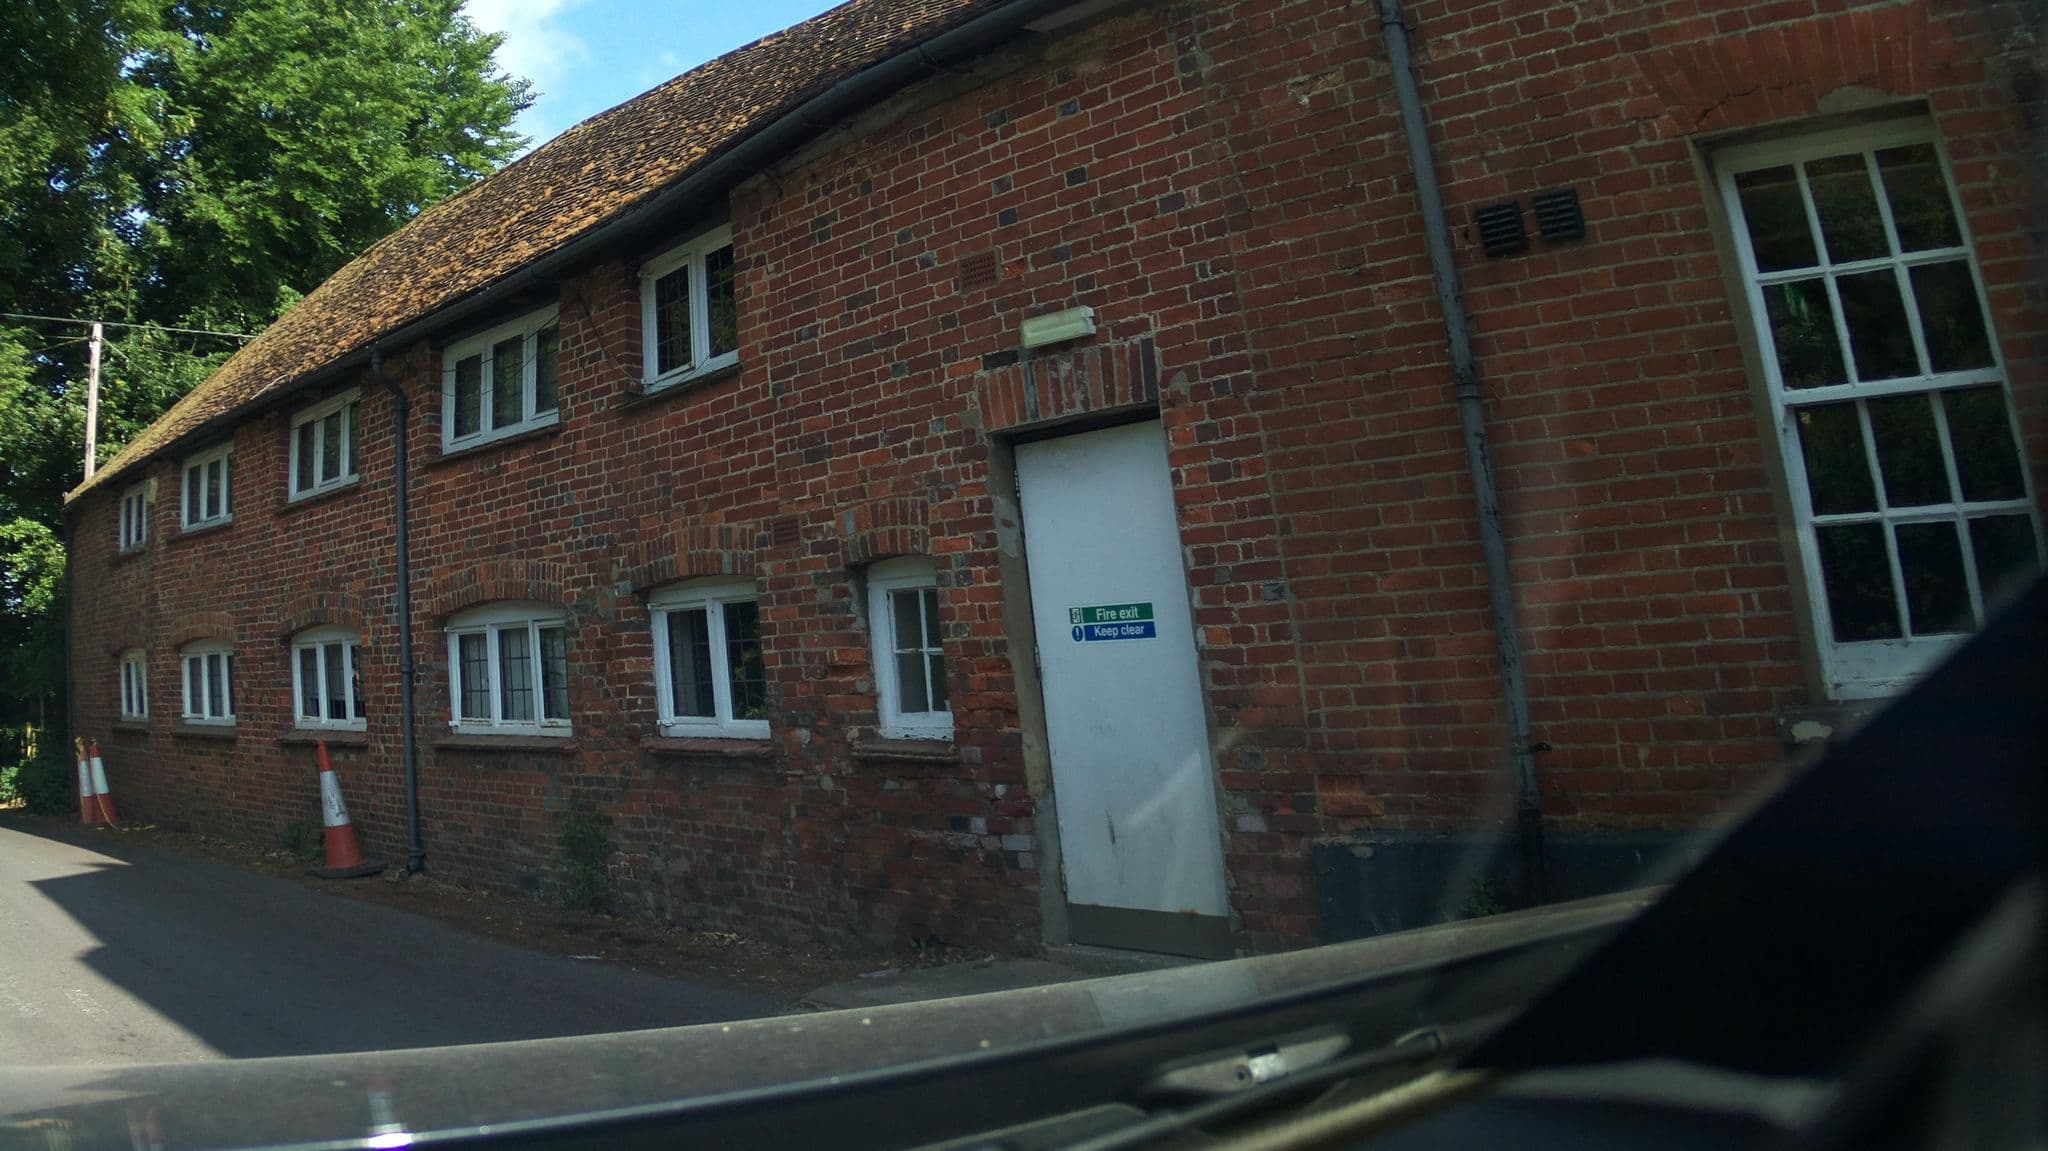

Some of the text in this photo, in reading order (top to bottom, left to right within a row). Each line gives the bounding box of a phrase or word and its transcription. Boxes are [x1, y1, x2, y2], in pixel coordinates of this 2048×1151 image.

[1095, 606, 1140, 621] Fire exit
[1094, 625, 1145, 638] Keep clear
